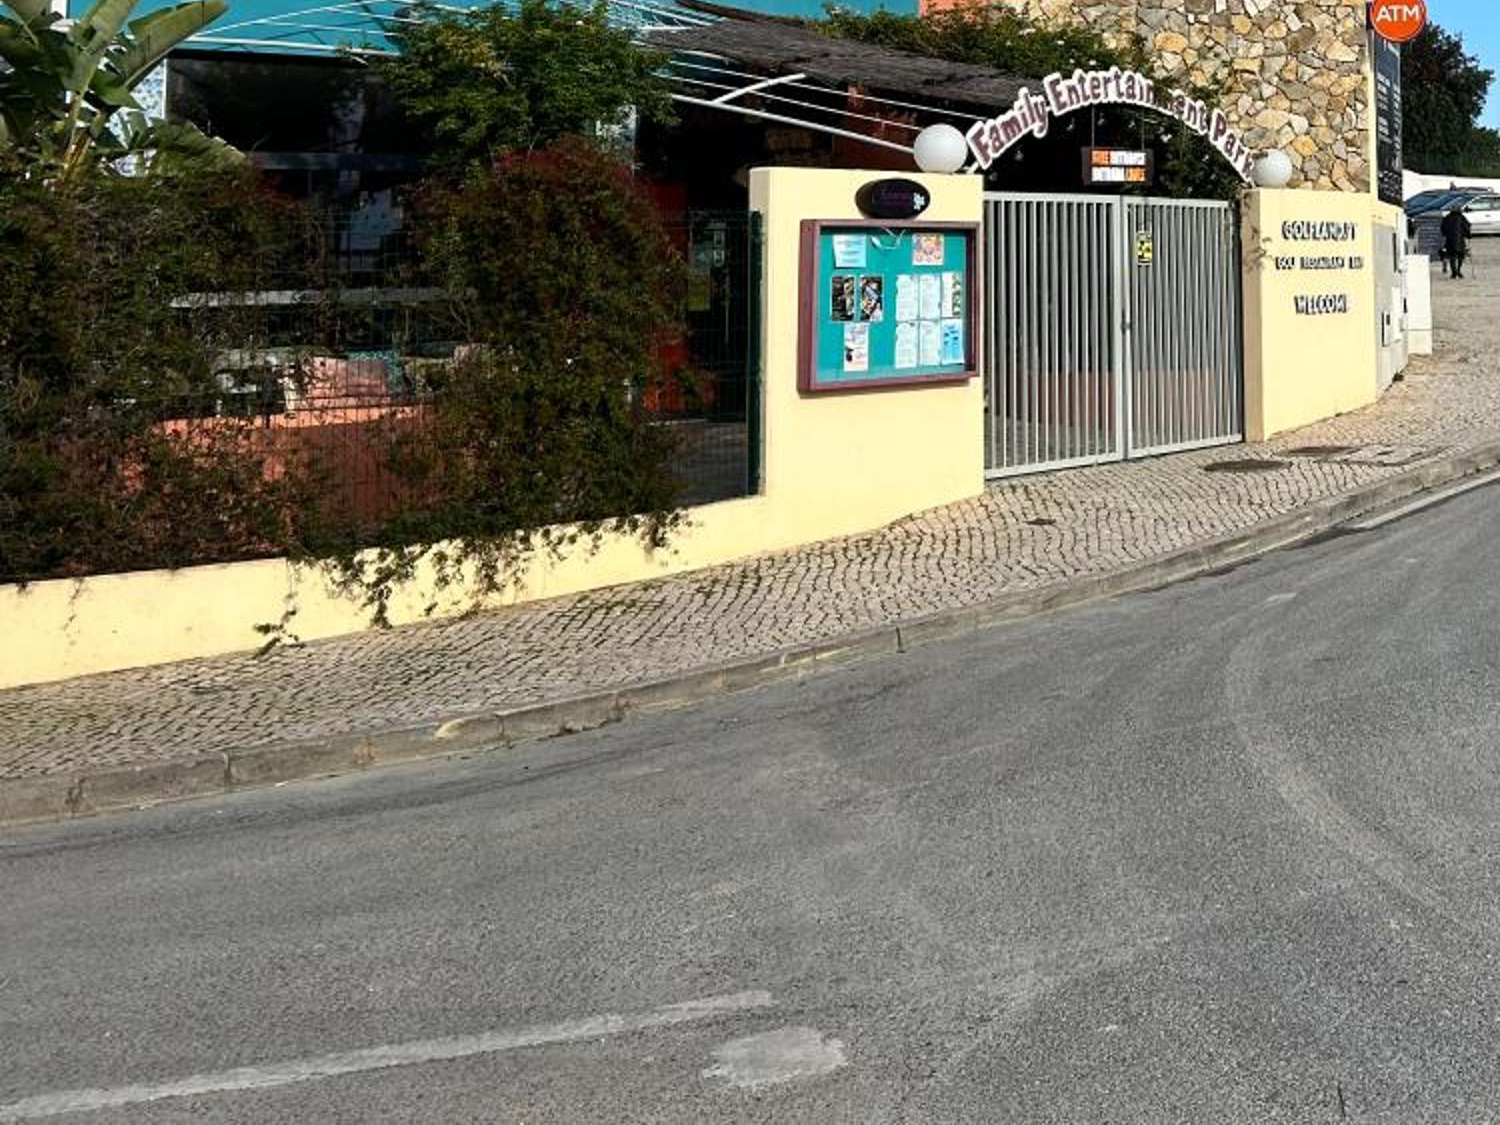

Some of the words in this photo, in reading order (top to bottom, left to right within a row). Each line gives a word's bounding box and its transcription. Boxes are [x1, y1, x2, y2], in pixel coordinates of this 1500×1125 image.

[1376, 5, 1420, 23] ATM
[967, 88, 1047, 168] Family
[1045, 69, 1208, 135] Entertainent
